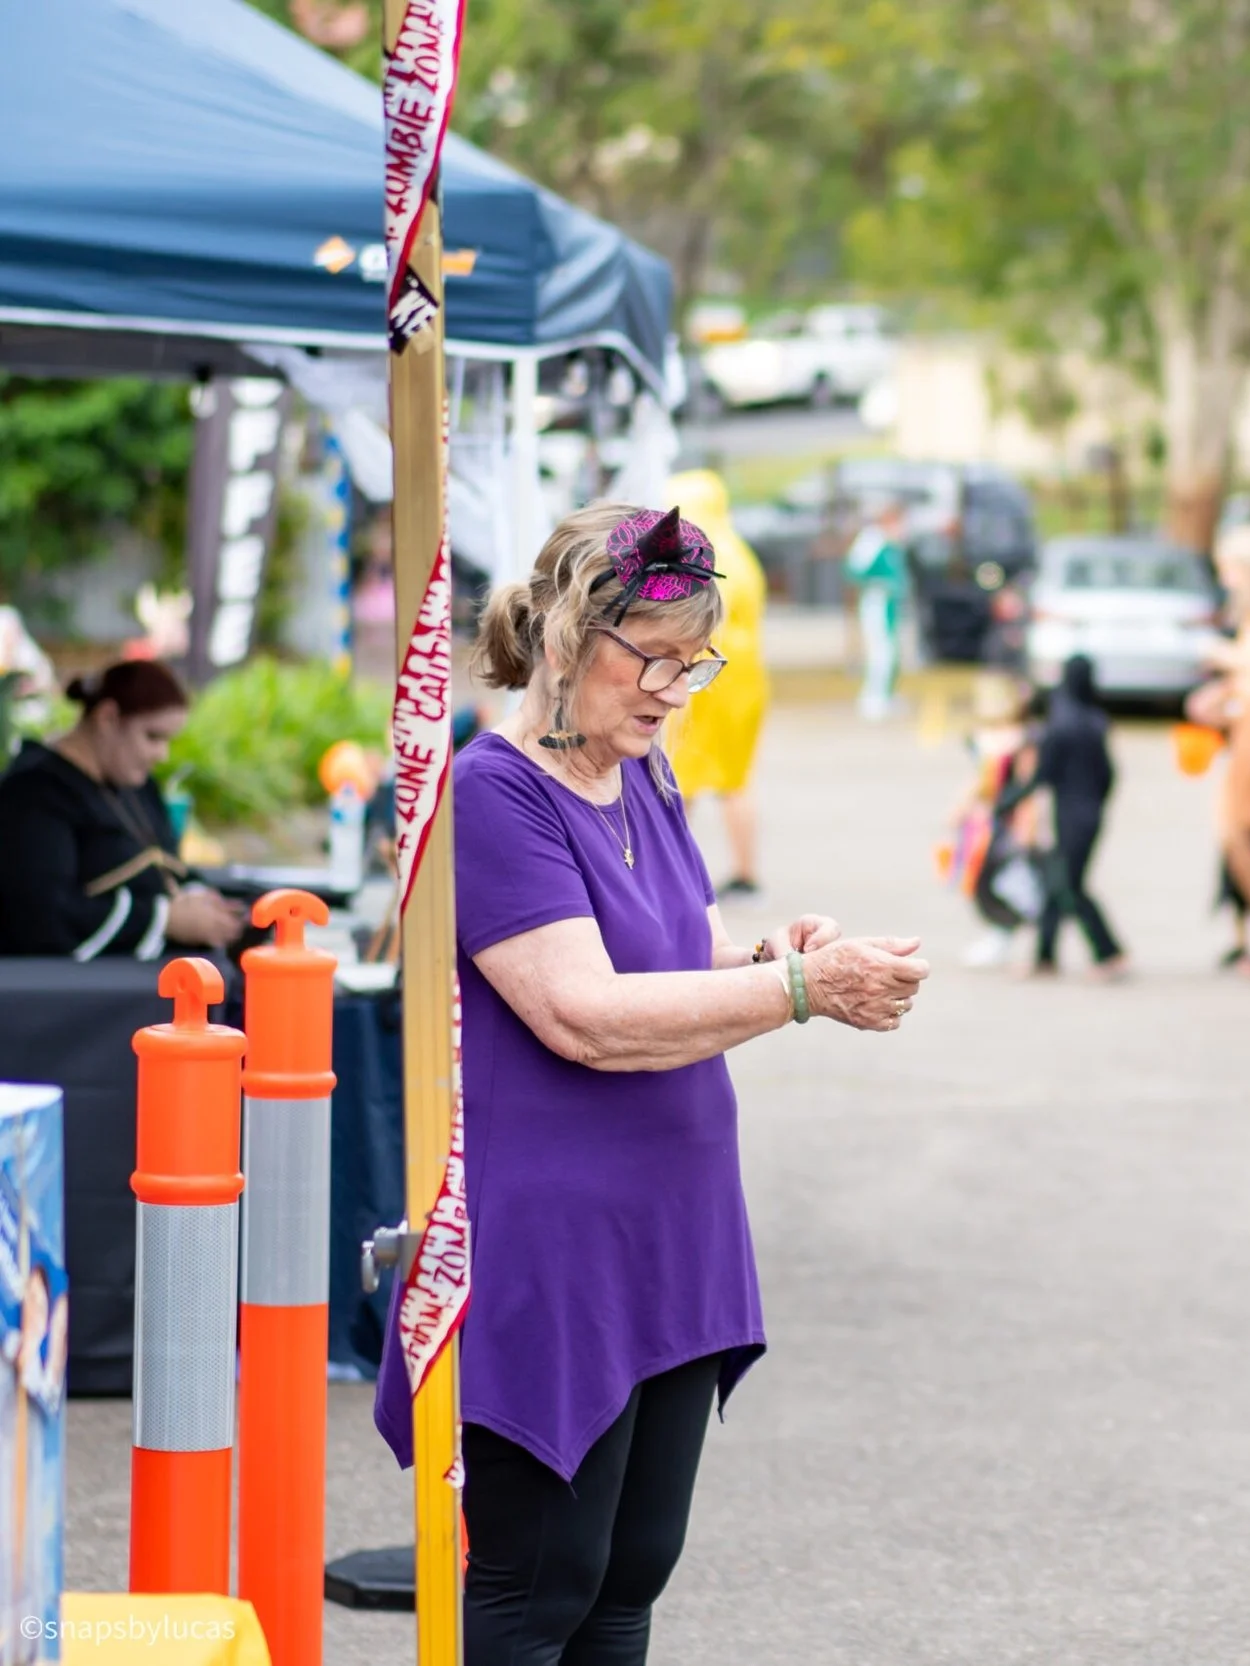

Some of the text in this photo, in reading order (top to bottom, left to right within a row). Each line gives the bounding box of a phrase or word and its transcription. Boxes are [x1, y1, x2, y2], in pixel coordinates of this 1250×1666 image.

[385, 12, 444, 217] ZOMBIE ZONE
[395, 742, 435, 824] ZONE
